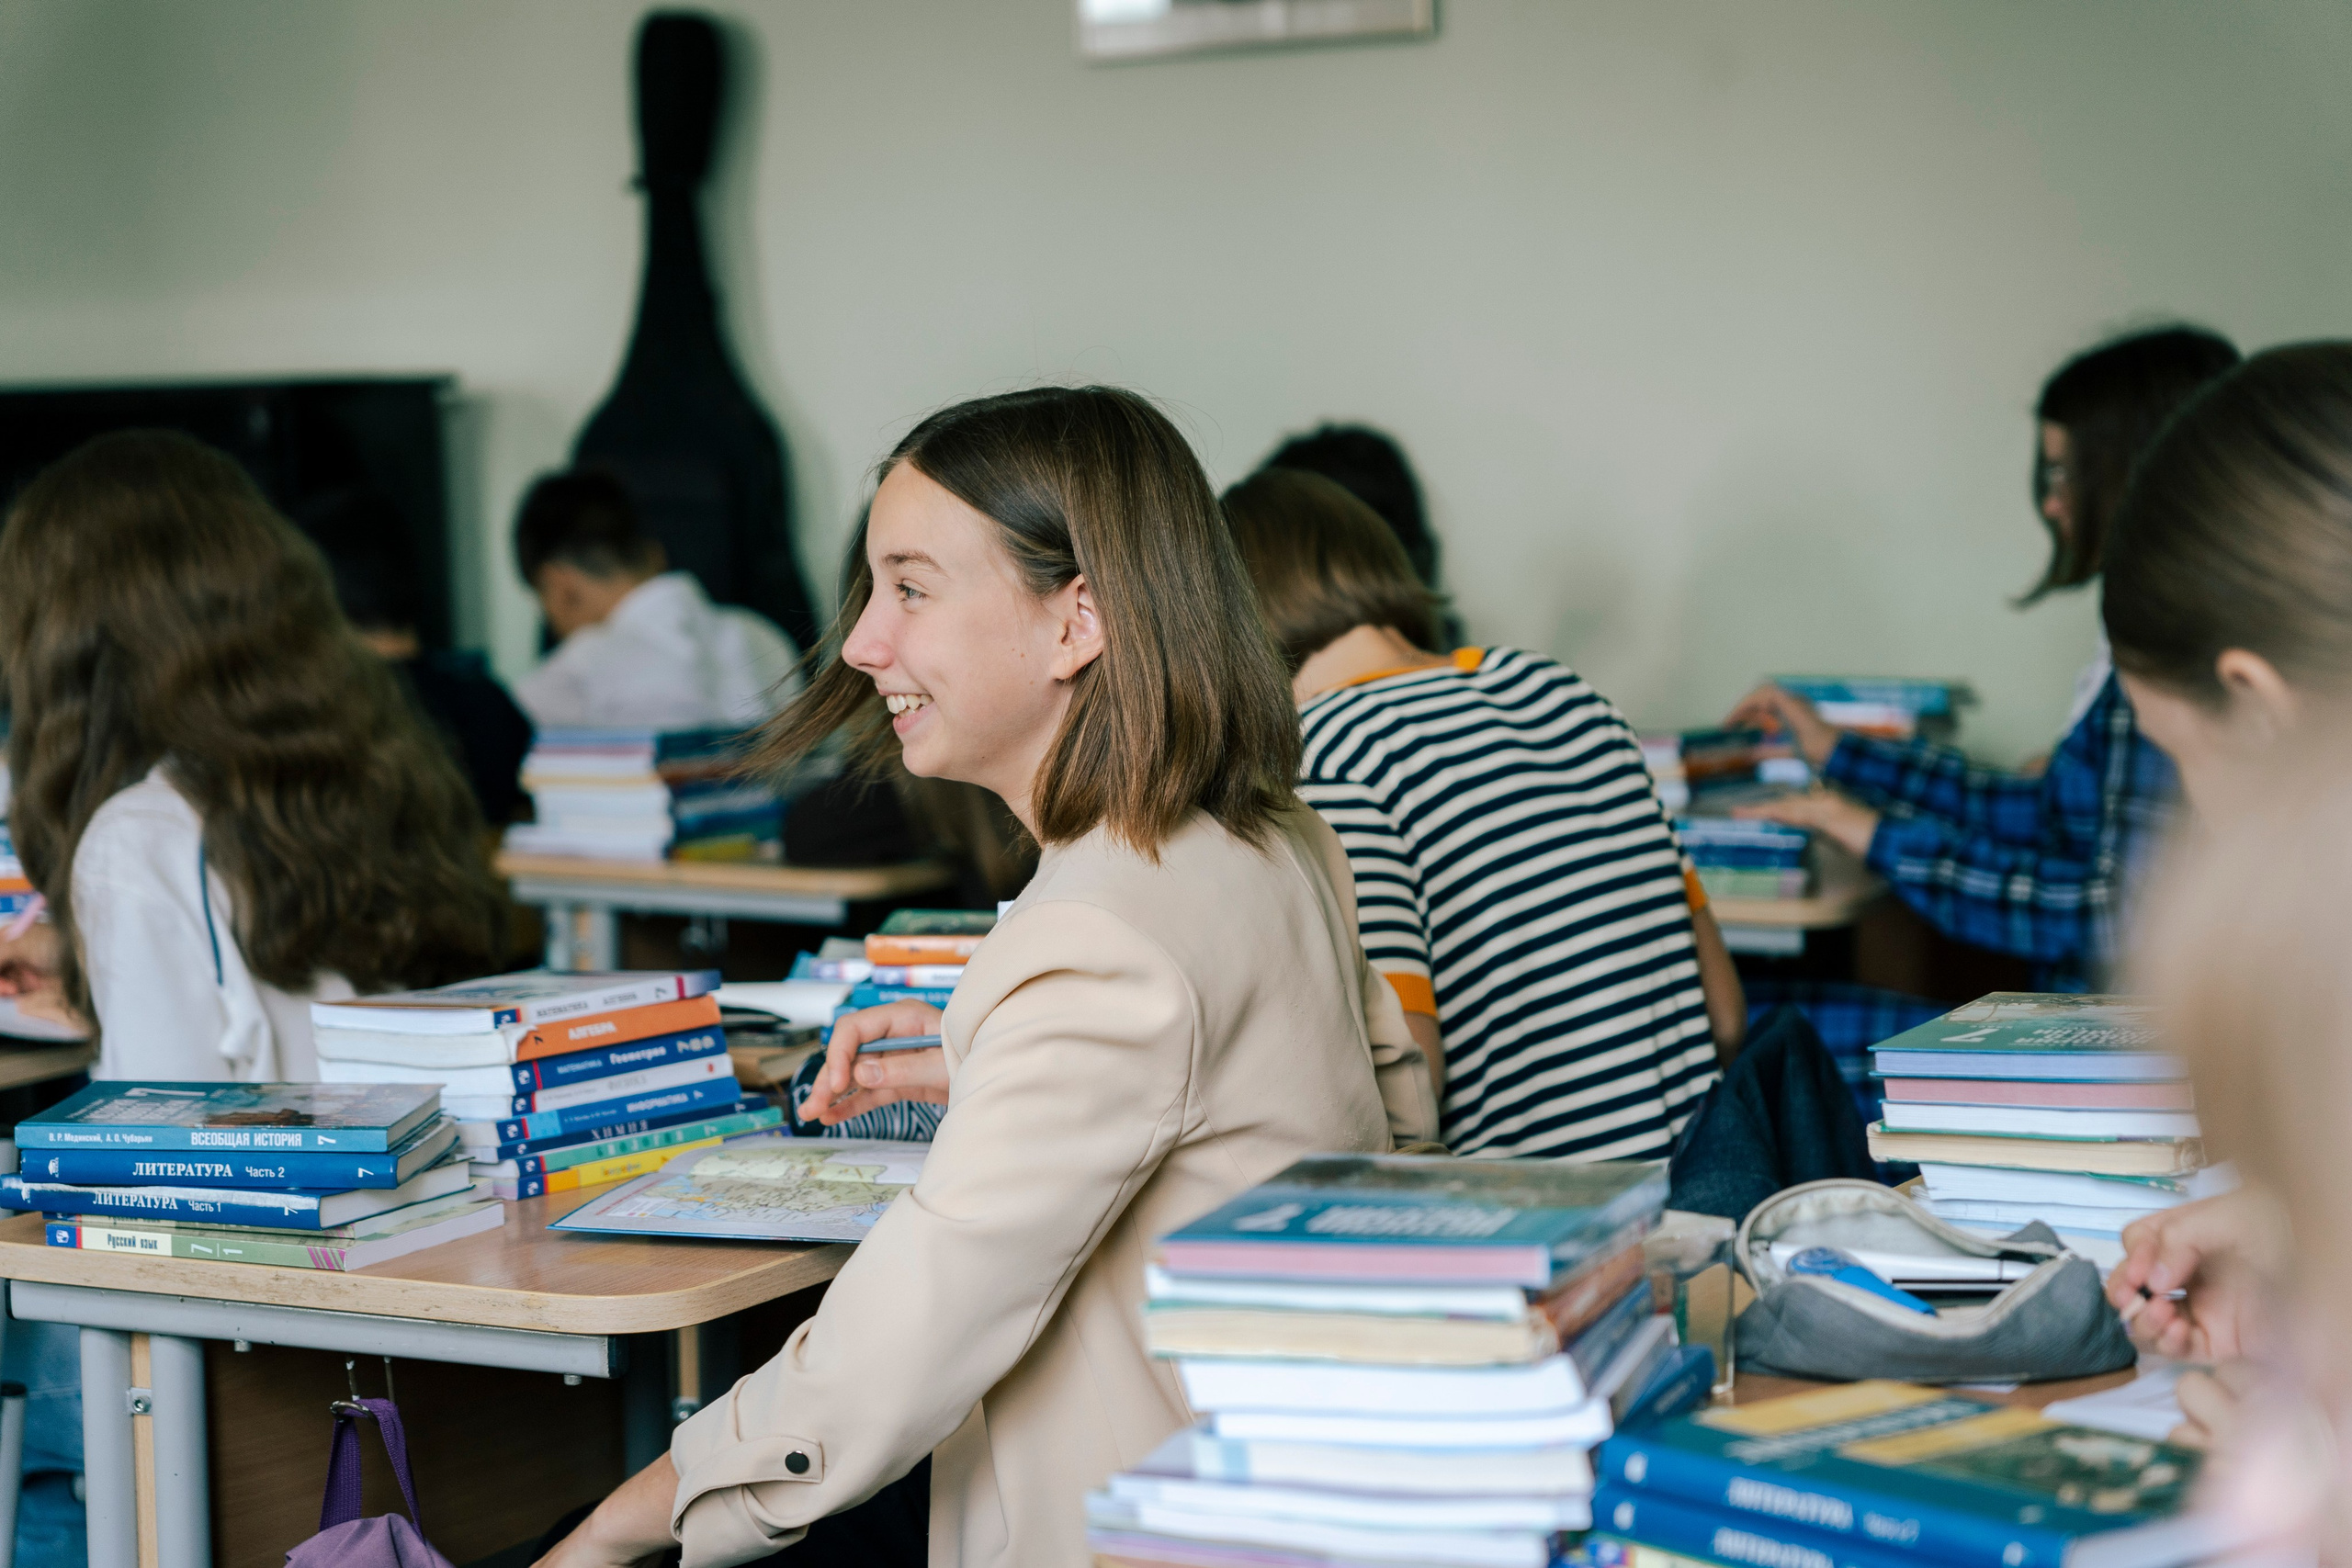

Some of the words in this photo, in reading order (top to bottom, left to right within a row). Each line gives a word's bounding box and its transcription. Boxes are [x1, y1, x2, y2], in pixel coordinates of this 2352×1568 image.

[568, 1021, 617, 1041] АЛГЕБРА
[591, 1119, 649, 1141] ХИМИЯ
[57, 1133, 63, 1143] Р.
[64, 1133, 103, 1144] Мединский,
[106, 1133, 113, 1143] А.
[122, 1134, 153, 1145] Чубарьян
[191, 1132, 249, 1147] ВСЕОБЩАЯ
[254, 1132, 302, 1146] ИСТОРИЯ
[317, 1134, 336, 1145] 7
[132, 1162, 233, 1178] ЛИТЕРАТУРА
[245, 1166, 276, 1178] Часть
[277, 1167, 285, 1178] 2
[358, 1168, 374, 1178] 7
[93, 1192, 178, 1210] ЛИТЕРАТУРА
[188, 1200, 214, 1213] Часть
[217, 1202, 221, 1213] 1
[107, 1234, 136, 1249] Русский
[140, 1238, 158, 1250] язык
[191, 1243, 213, 1255] 7
